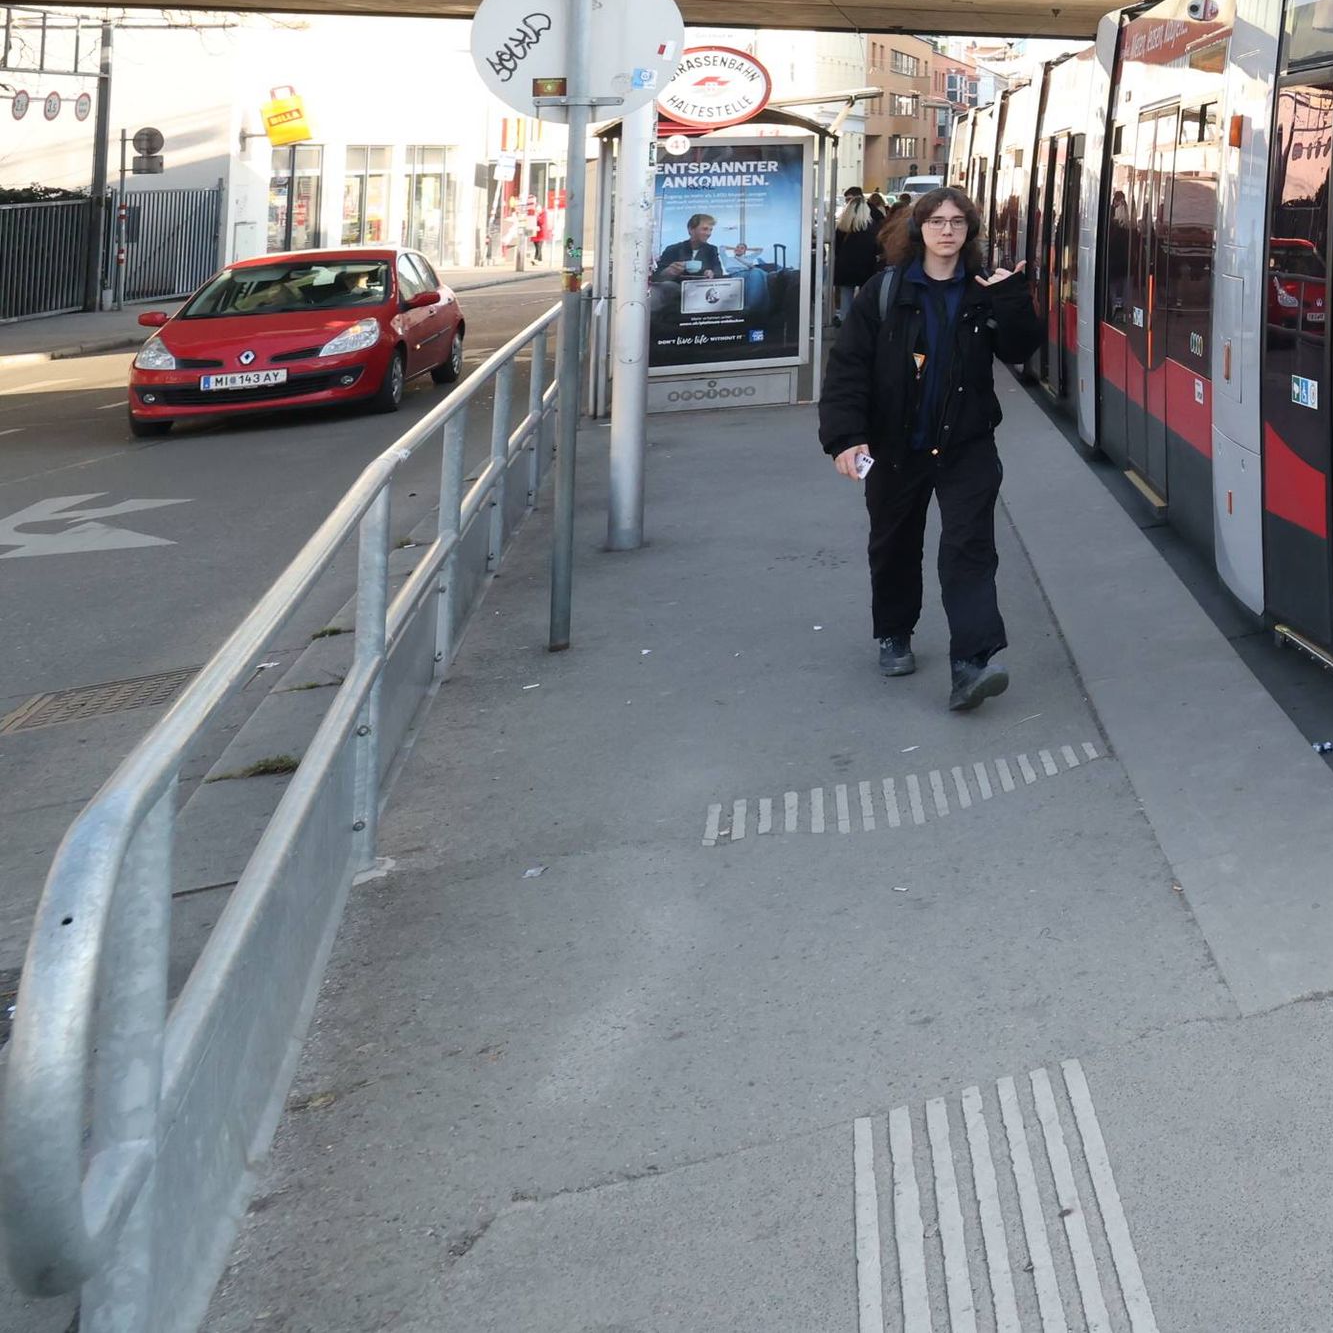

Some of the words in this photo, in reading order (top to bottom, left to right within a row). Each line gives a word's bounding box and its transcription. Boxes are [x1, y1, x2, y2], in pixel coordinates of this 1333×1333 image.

[667, 95, 754, 118] HALTESTELLE
[654, 160, 778, 175] ENTSPANNTER
[661, 174, 770, 188] ANKOMMEN.
[214, 376, 228, 386] MI
[239, 373, 260, 384] 143
[263, 371, 280, 382] AY
